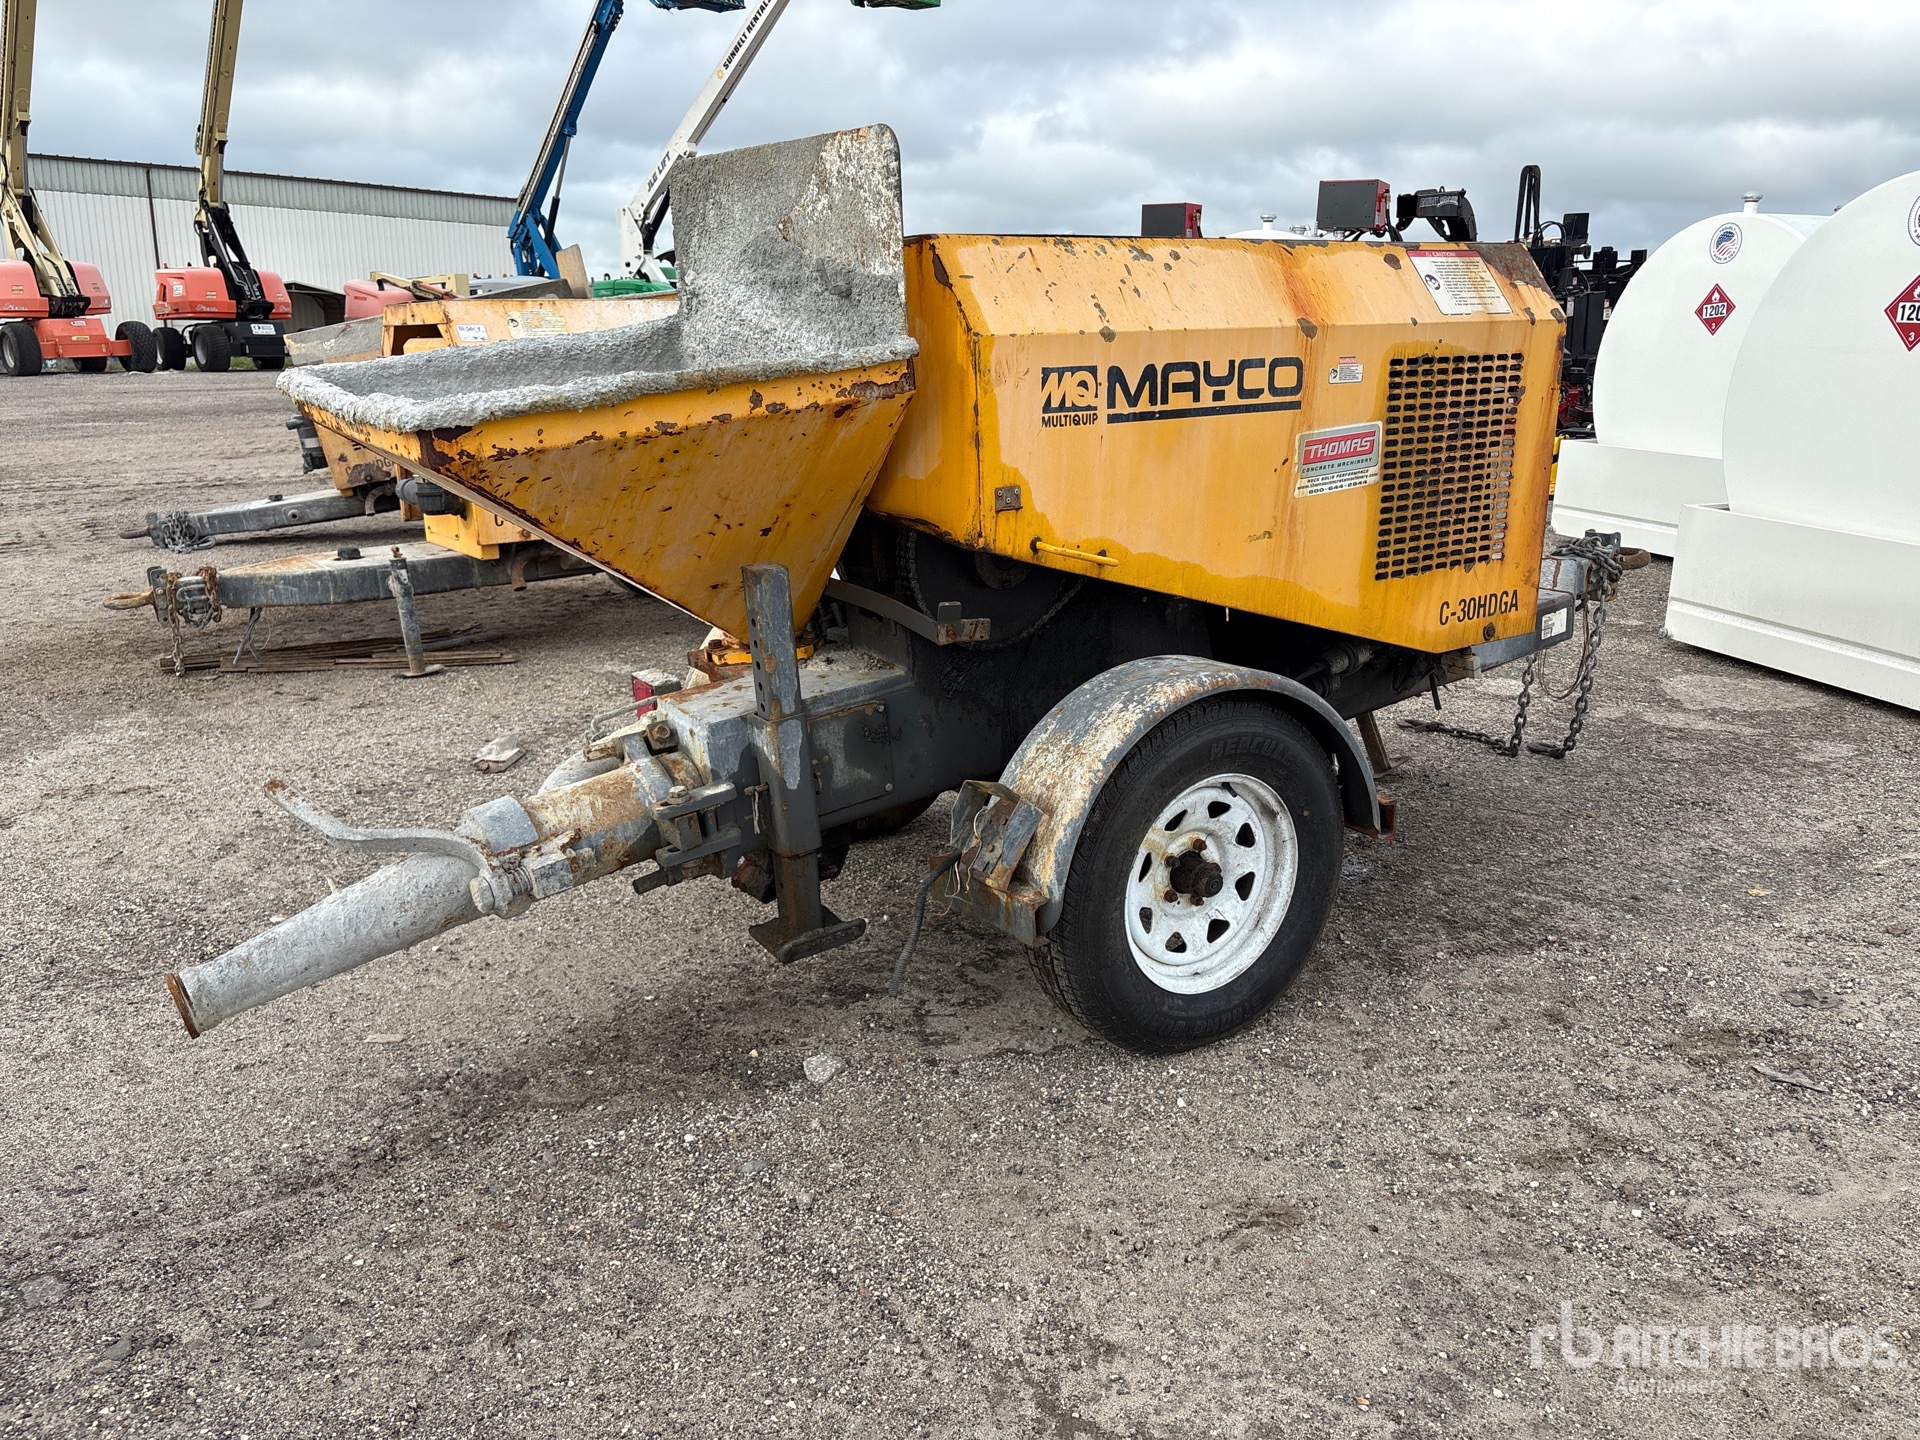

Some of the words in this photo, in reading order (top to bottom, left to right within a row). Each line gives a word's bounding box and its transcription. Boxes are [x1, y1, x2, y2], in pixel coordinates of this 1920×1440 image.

[722, 31, 748, 70] SUNBELT
[647, 171, 658, 192] JLG
[657, 150, 670, 175] LIFT
[1704, 304, 1726, 317] 1202
[1711, 322, 1716, 330] 3
[1908, 331, 1916, 342] 3
[1041, 370, 1098, 408] MQ
[1106, 356, 1304, 410] MAYCO
[1041, 412, 1098, 428] MULTIQUIP
[1304, 436, 1376, 459] THOMAS
[1301, 463, 1335, 474] CONCRETE
[1336, 457, 1373, 468] MACHINERY
[1321, 473, 1335, 482] SOLID
[1336, 469, 1369, 479] PERFORMANCE
[1439, 589, 1519, 626] C-30HDGA
